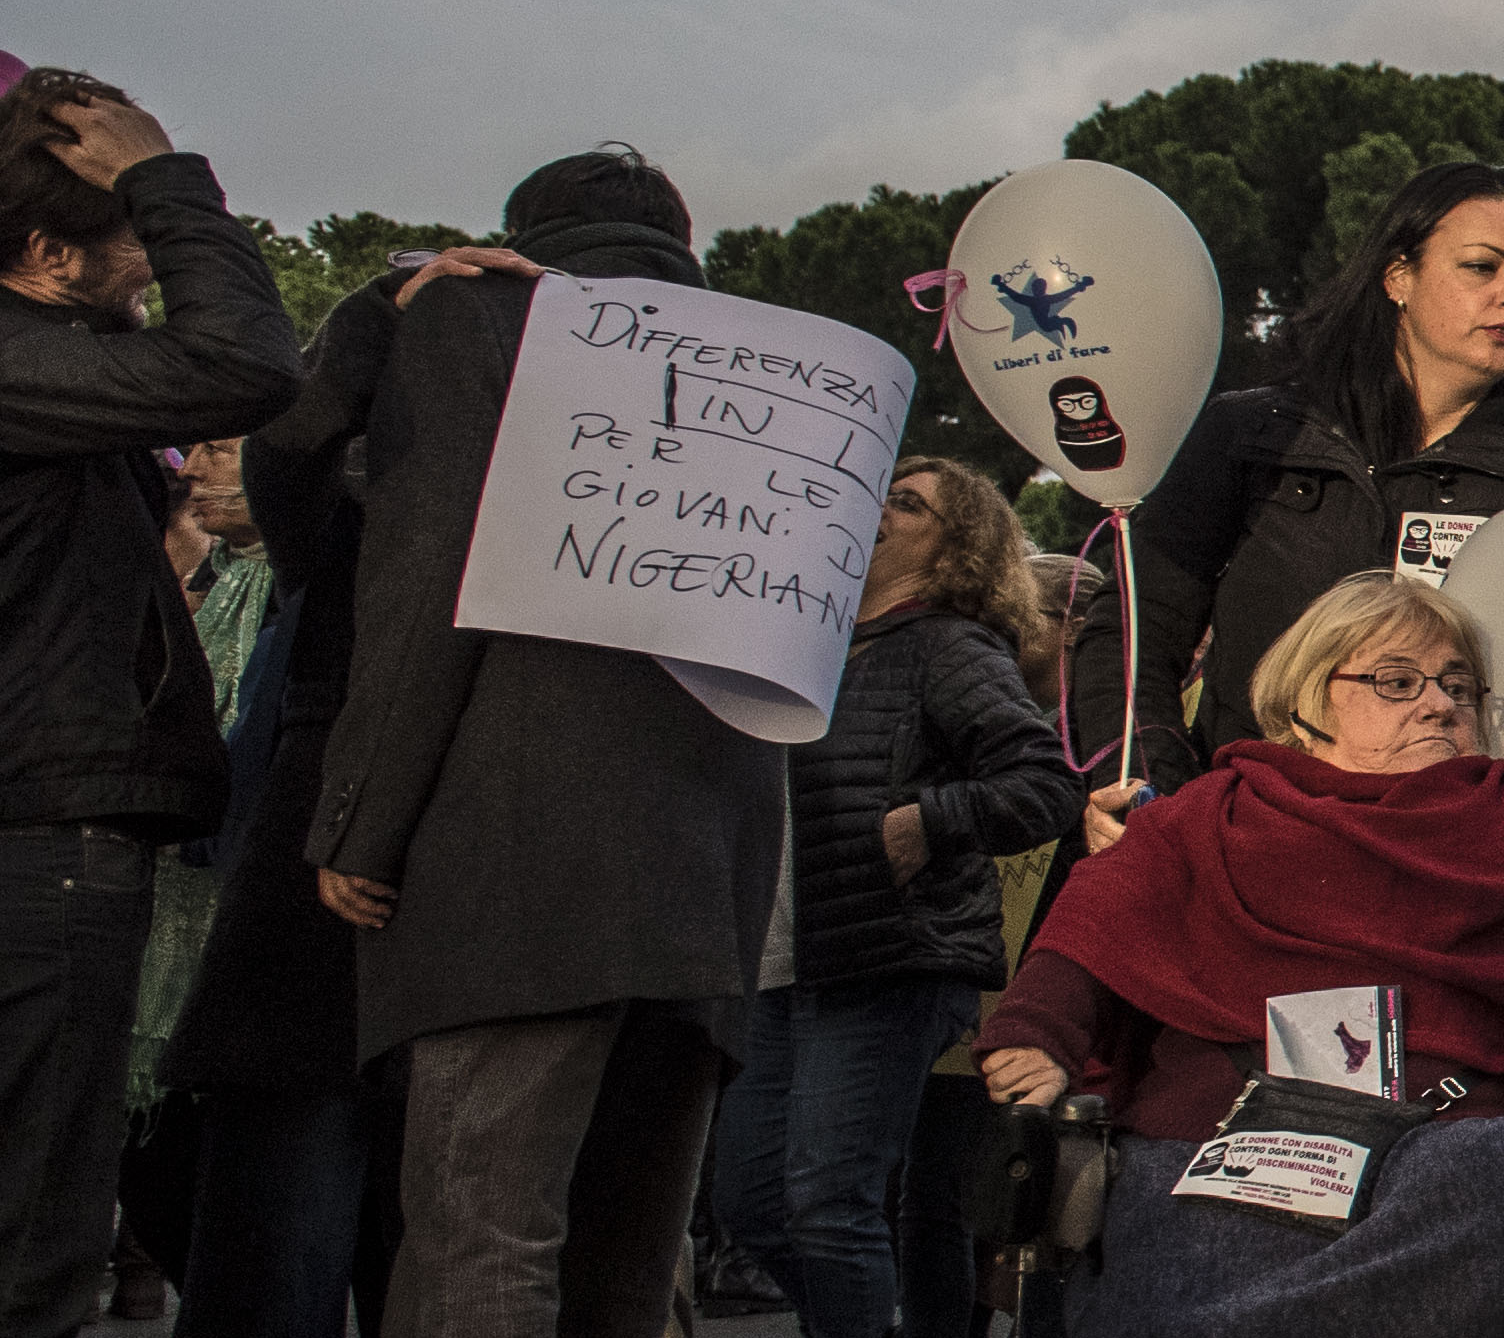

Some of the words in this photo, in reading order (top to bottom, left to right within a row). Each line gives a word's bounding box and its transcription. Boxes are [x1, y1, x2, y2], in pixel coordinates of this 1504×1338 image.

[571, 413, 686, 464] PER
[768, 470, 841, 509] LE
[1435, 520, 1446, 530] LE
[1447, 522, 1474, 531] DONNE
[1432, 532, 1465, 542] CONTRO
[1234, 1136, 1245, 1145] LE
[1248, 1136, 1280, 1145] DONNE
[1282, 1138, 1301, 1148] CON
[1228, 1145, 1266, 1154] CONTRO
[1268, 1147, 1291, 1156] OGNI
[1293, 1149, 1325, 1162] FORMA
[1326, 1156, 1338, 1165] DI
[1256, 1157, 1338, 1179] DISCRIMINAZIONE
[1339, 1172, 1347, 1181] E
[1310, 1176, 1355, 1197] VIOLENZA
